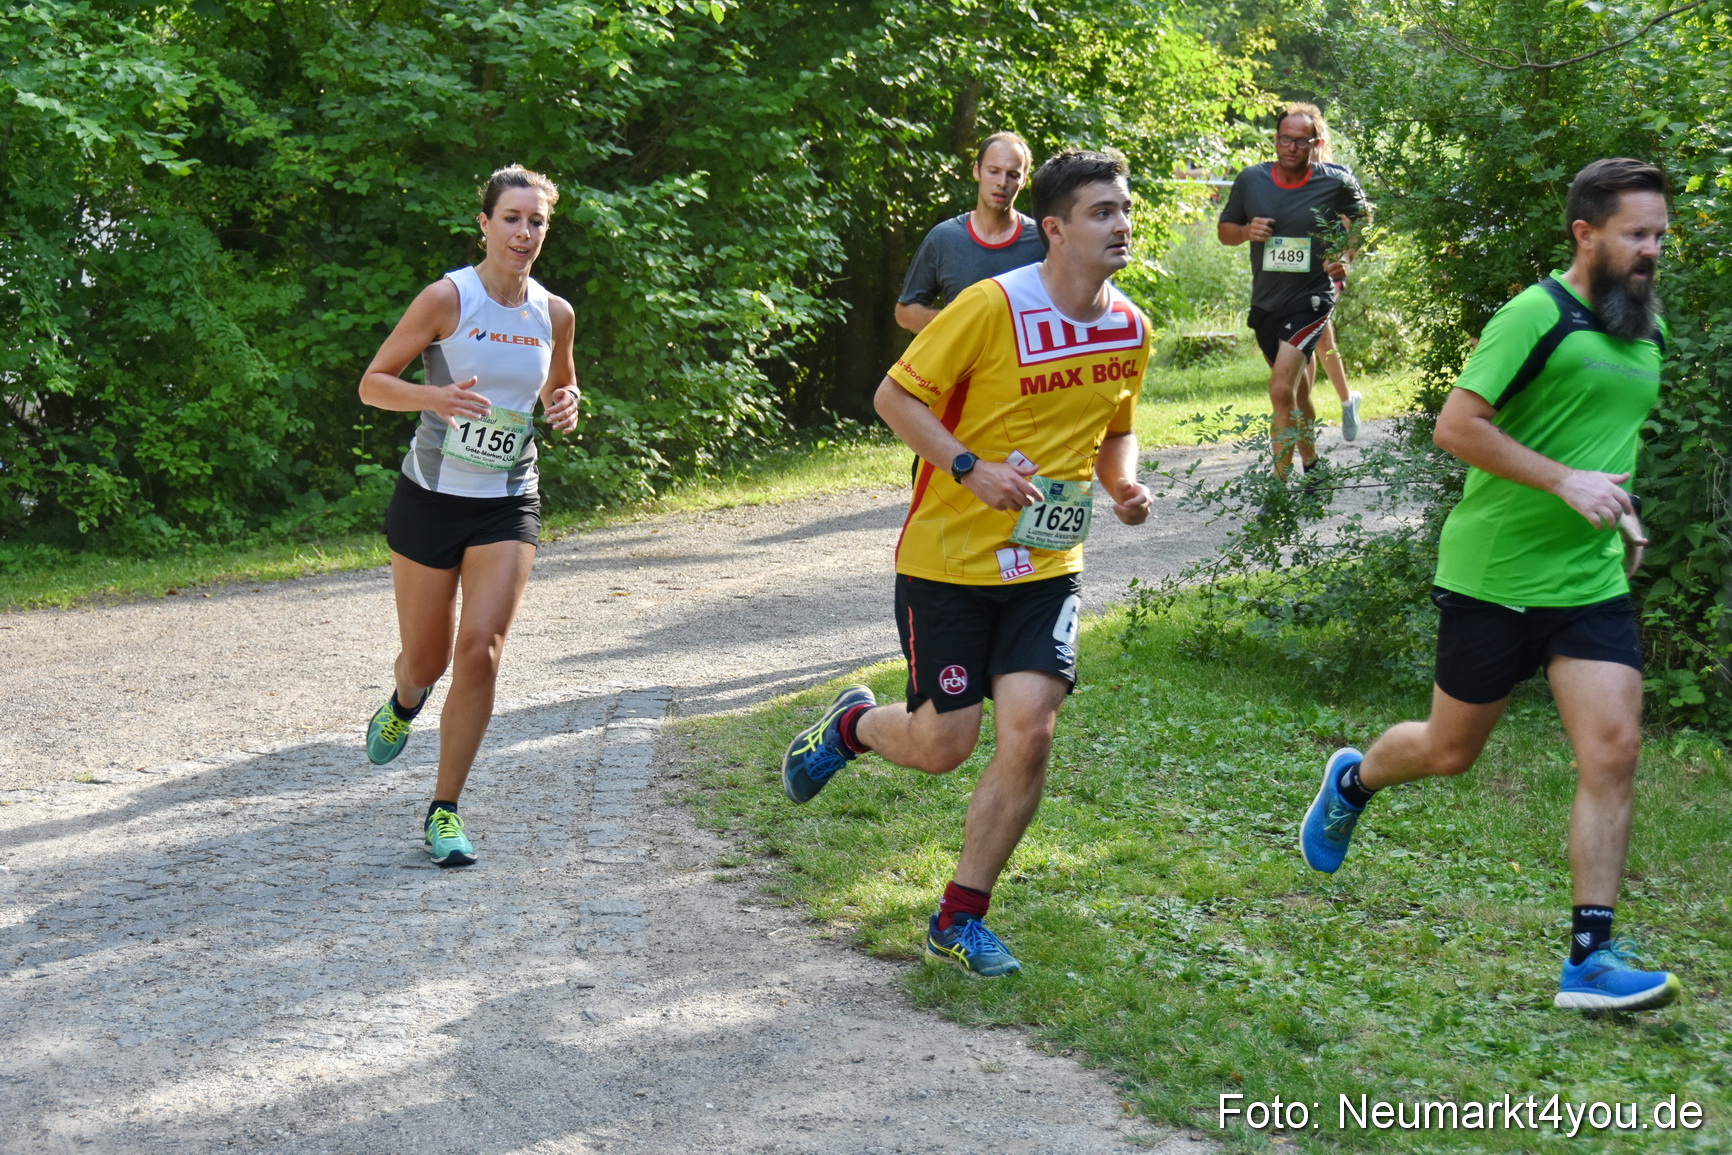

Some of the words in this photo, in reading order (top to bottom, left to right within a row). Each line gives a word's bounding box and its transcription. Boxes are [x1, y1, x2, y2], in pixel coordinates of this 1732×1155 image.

[1270, 249, 1304, 262] 1489
[489, 332, 543, 347] KLEBL
[1020, 367, 1084, 396] MAX
[1092, 357, 1139, 383] BÖGL
[459, 422, 516, 454] 1156
[1034, 503, 1085, 532] 1629
[943, 676, 964, 689] FCN
